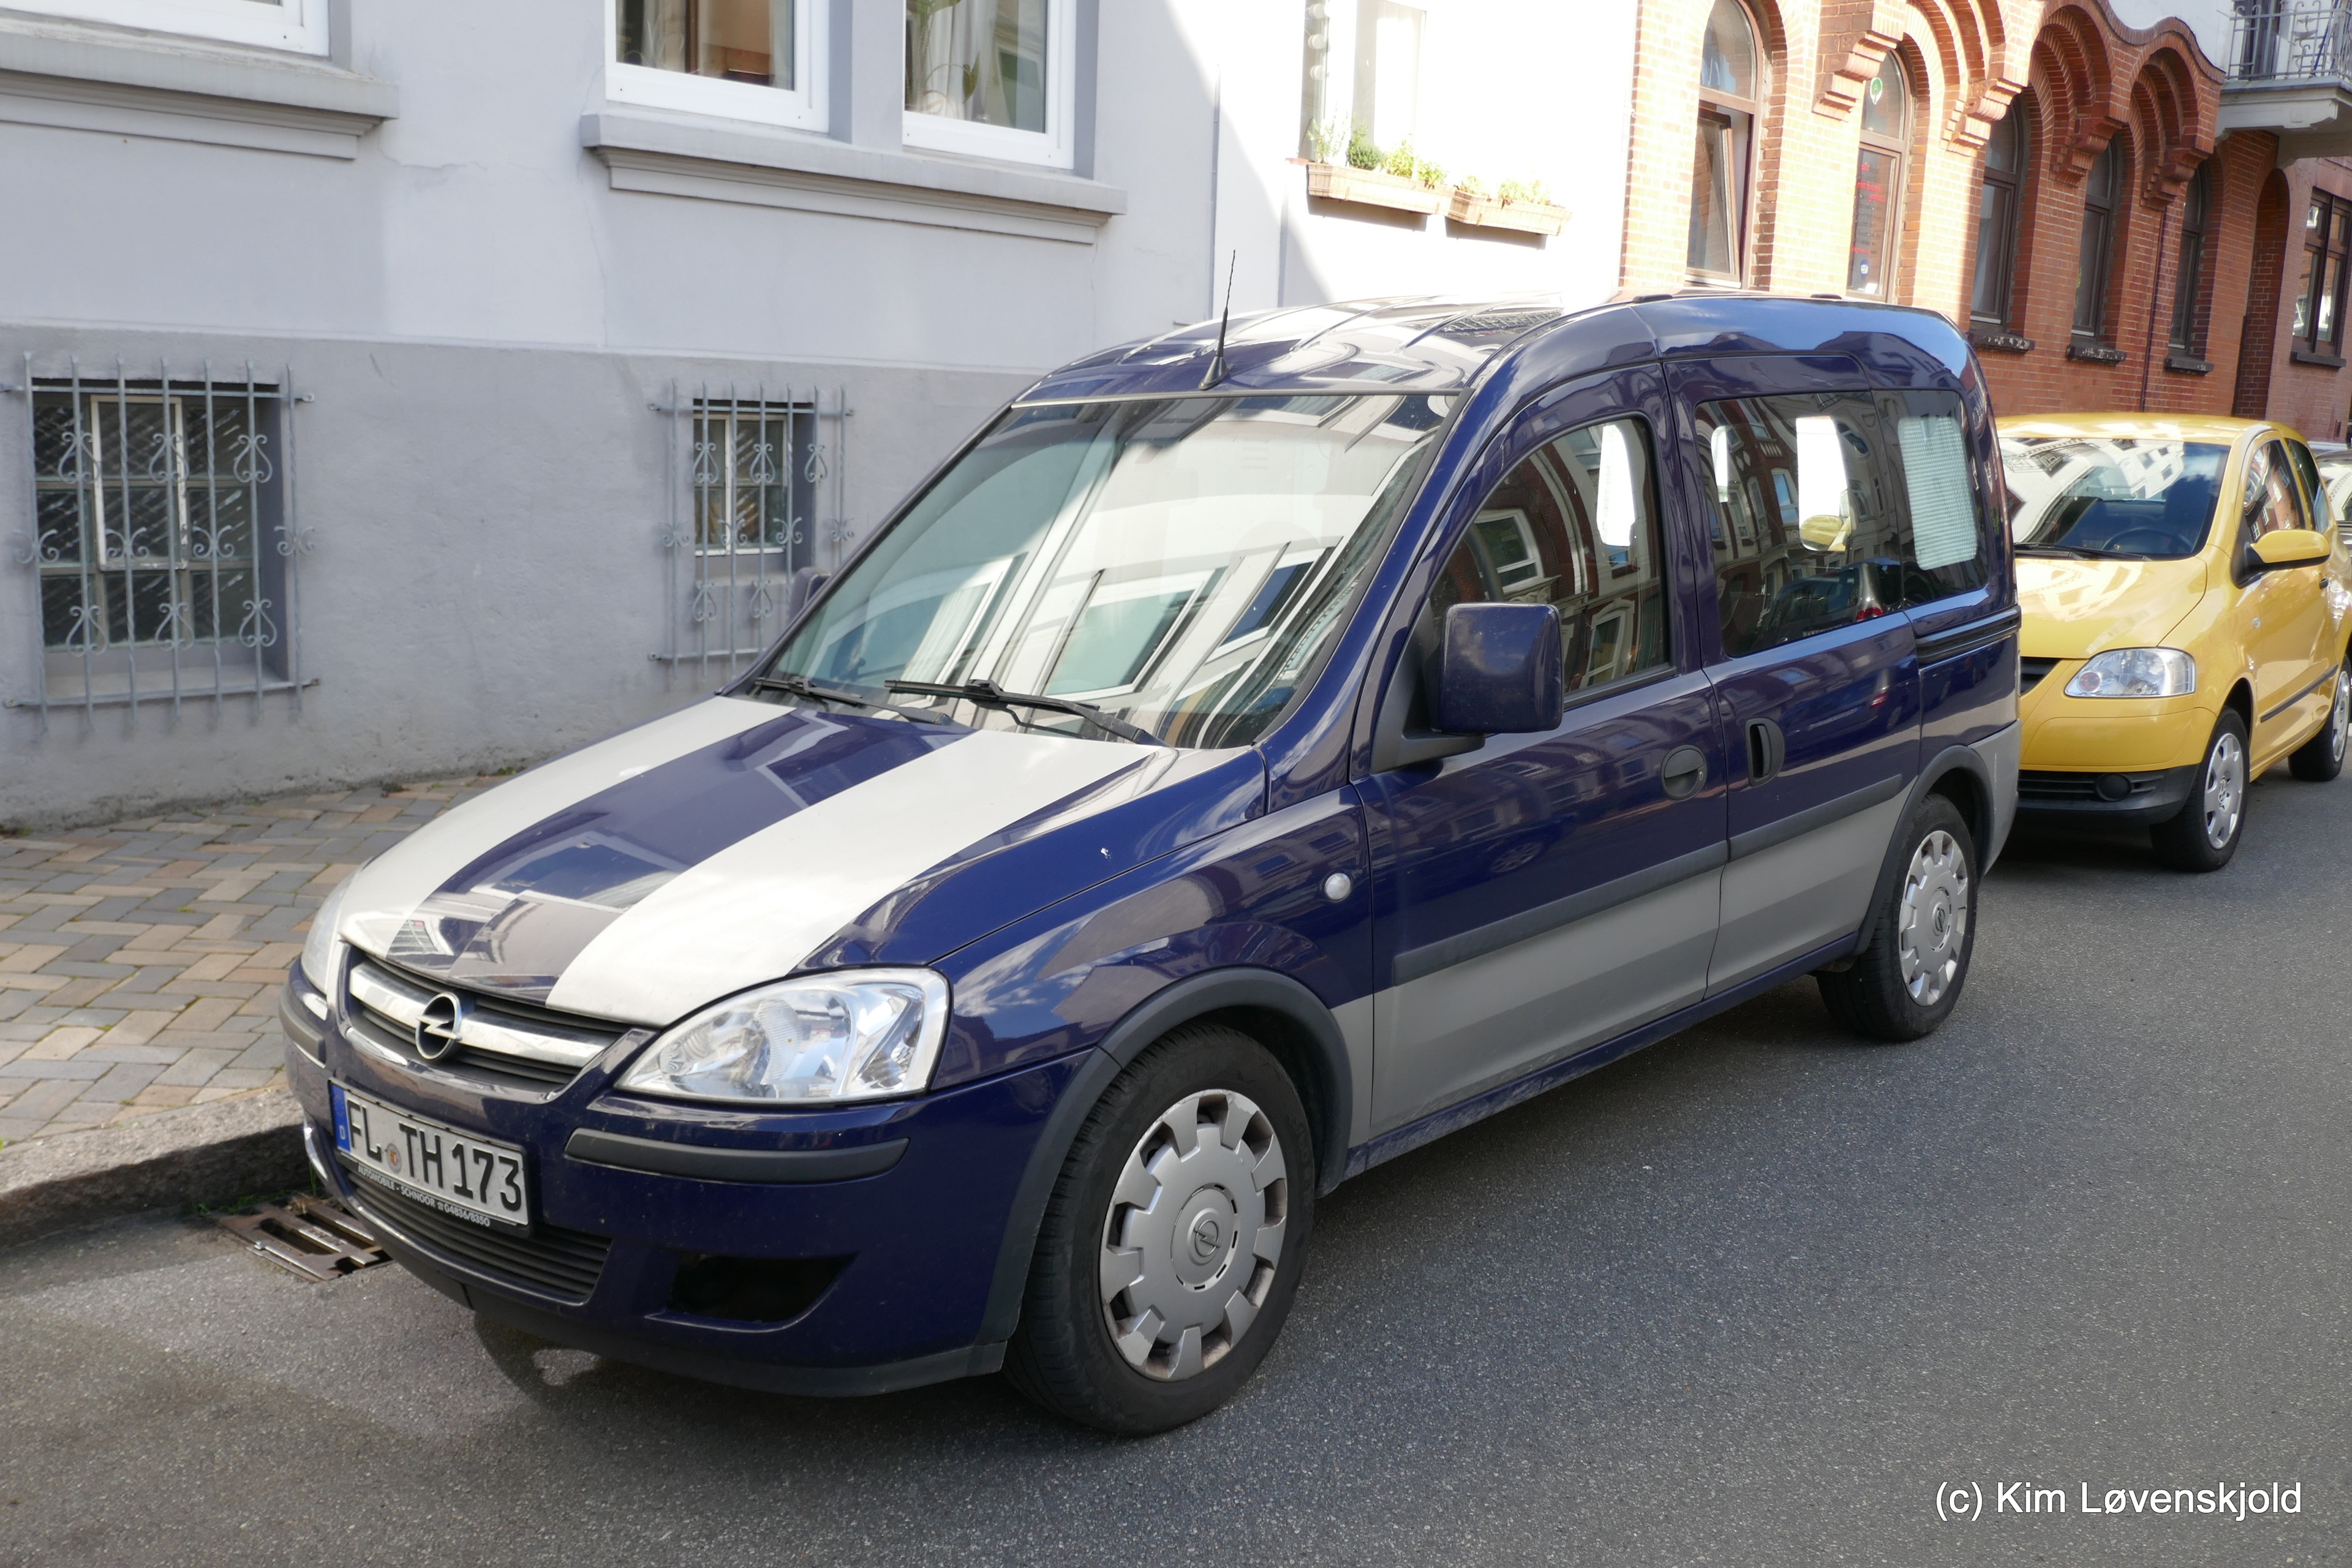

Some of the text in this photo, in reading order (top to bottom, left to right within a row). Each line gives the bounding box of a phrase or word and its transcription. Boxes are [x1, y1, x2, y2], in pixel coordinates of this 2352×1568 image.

[347, 1099, 382, 1163] FL
[358, 1165, 395, 1191] AUTOMOBILE
[401, 1186, 435, 1207] SCHNOOR
